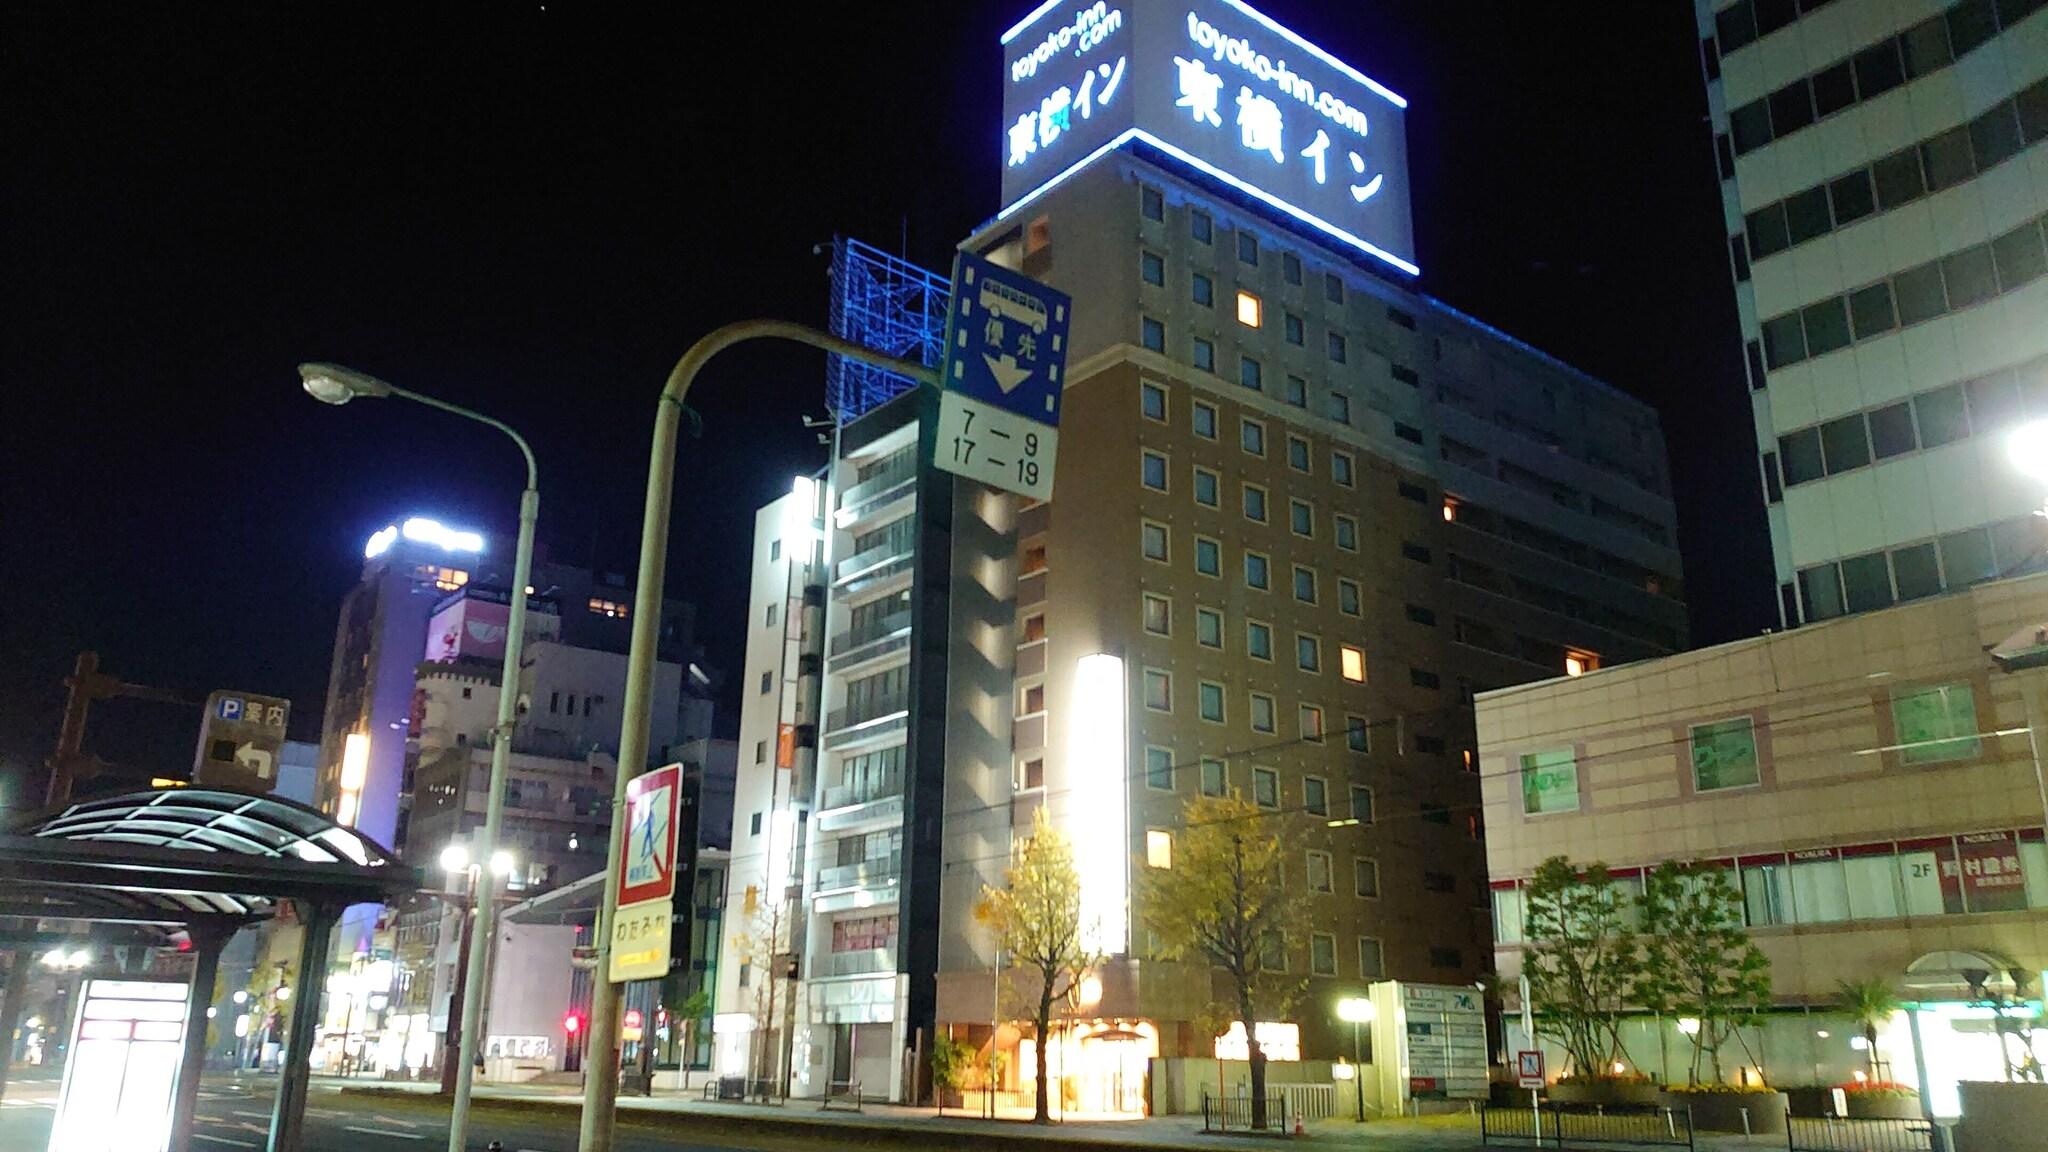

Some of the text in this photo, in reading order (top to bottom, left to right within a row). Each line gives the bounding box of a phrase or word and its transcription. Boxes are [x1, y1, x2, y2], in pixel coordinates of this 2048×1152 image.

[1011, 1, 1106, 82] toyoko-inn
[1074, 9, 1121, 57] .com
[1187, 10, 1368, 137] toyoko-inn.com
[1008, 56, 1125, 167] 東横イン
[1173, 55, 1383, 203] 東横イン
[984, 318, 1038, 362] 優先
[962, 409, 975, 436] 7
[1025, 433, 1038, 458] 9
[953, 437, 976, 465] 17
[1017, 458, 1039, 486] 19
[223, 700, 239, 717] P
[1912, 863, 1931, 878] 2F
